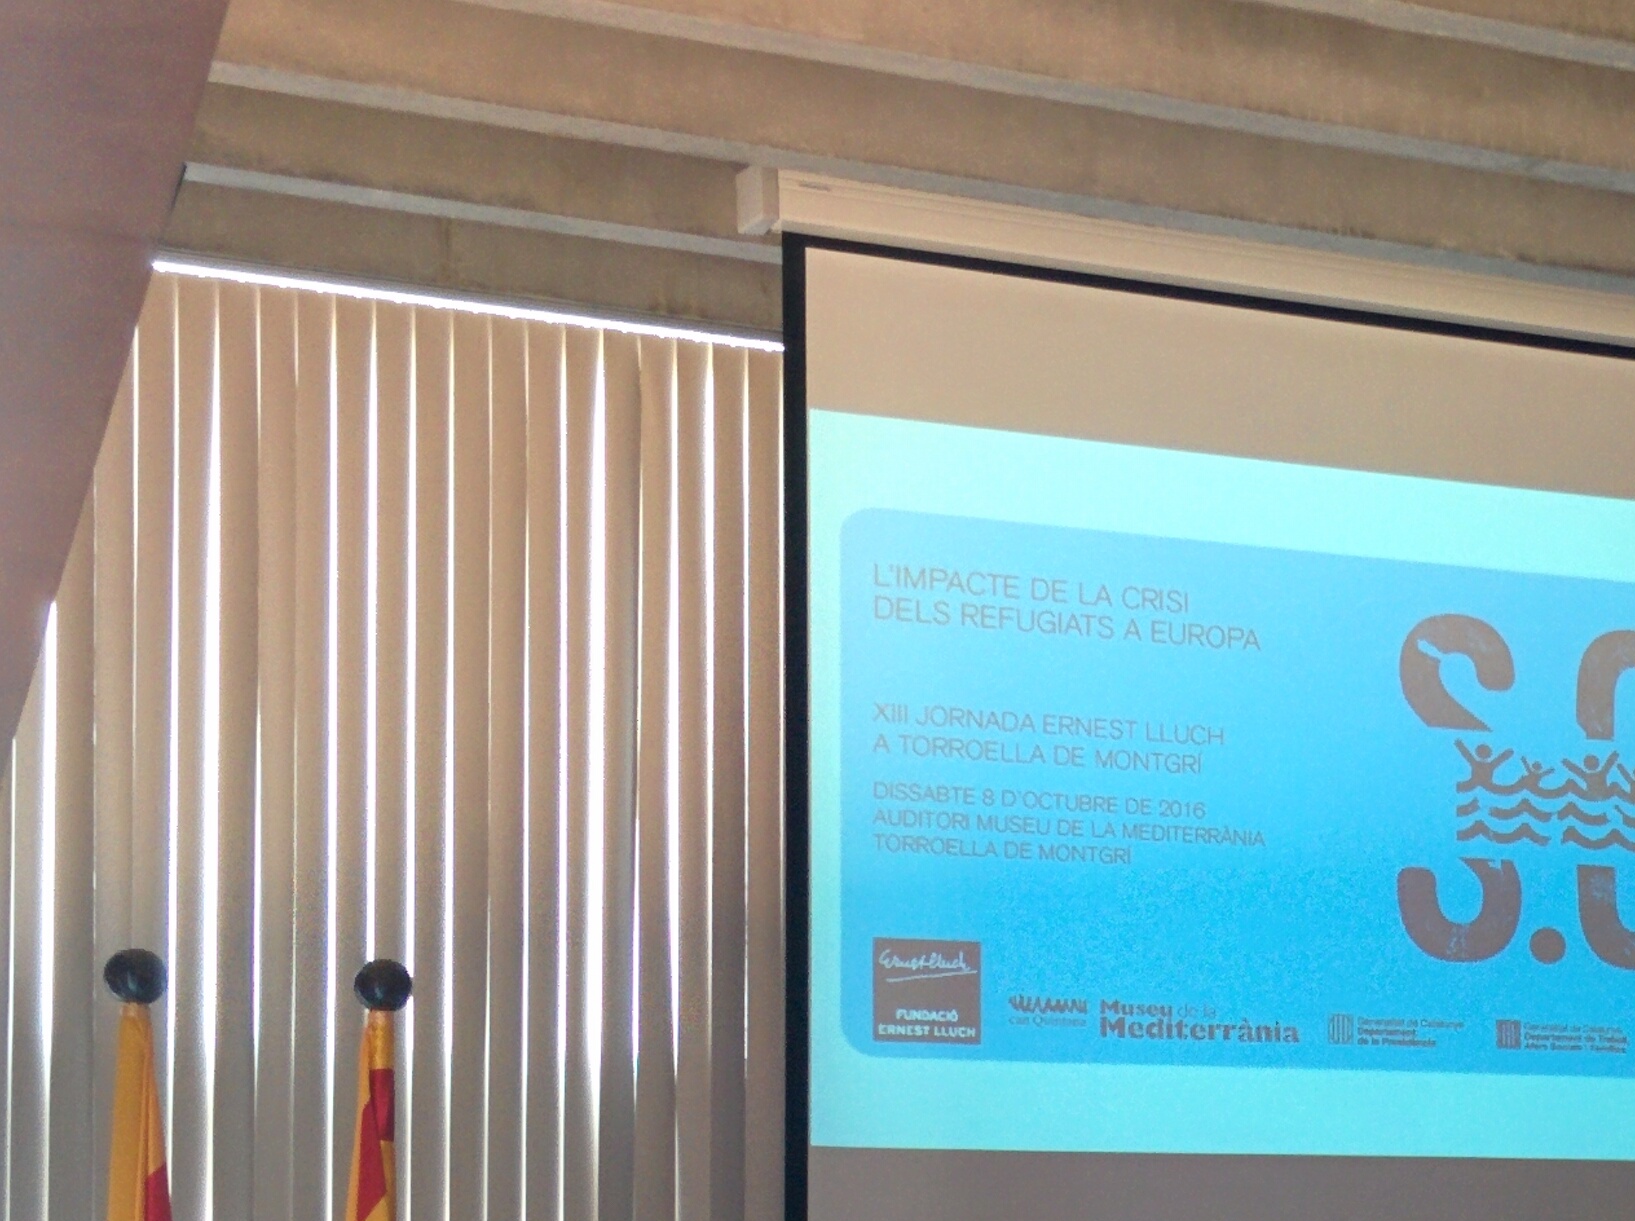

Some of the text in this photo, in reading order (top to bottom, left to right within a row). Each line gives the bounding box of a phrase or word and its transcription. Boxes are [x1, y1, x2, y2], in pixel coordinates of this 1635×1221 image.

[873, 563, 1190, 613] L'IMPACTE DE LA CRISI
[873, 596, 1262, 651] DELS REFUGIATS A EUROPA
[873, 703, 1225, 746] XIII JORNADA ERNEST LLUCH
[873, 733, 890, 754] A
[899, 735, 1047, 765] TORROELLA
[1053, 745, 1085, 767] DE
[873, 781, 1206, 819] DISSABTE 8 D'OCTUBRE DE 2016
[873, 808, 970, 831] AUDITORI
[977, 814, 1051, 836] MUSEU
[1057, 818, 1085, 838] DE
[1091, 821, 1117, 840] LA
[873, 833, 998, 858] TORROELLA
[1004, 840, 1032, 860] DE
[1099, 999, 1217, 1018] Museu de la
[878, 1023, 976, 1038] ERNEST LLUCH
[1099, 1015, 1301, 1044] Mediterrània
